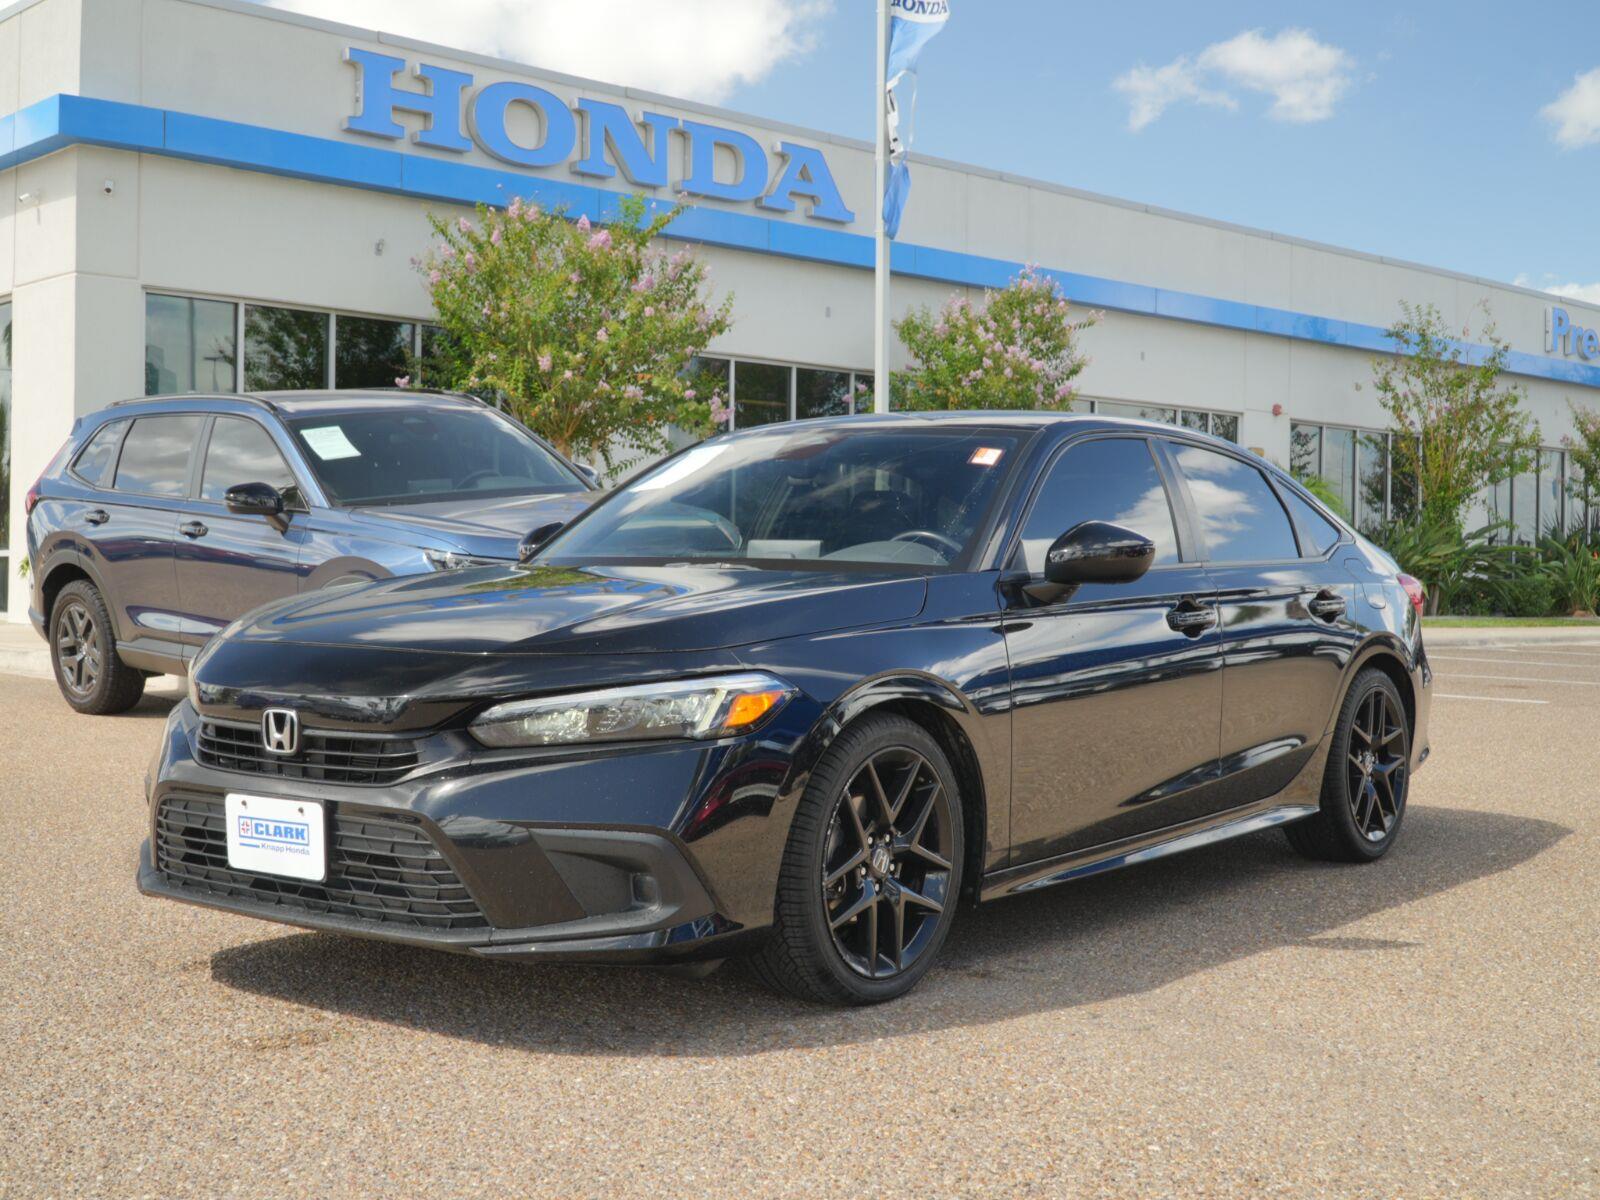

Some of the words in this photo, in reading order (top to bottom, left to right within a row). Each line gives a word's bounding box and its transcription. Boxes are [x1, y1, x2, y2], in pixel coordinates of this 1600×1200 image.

[344, 47, 855, 224] HONDA
[254, 822, 306, 841] CLARK
[286, 846, 310, 856] Honda
